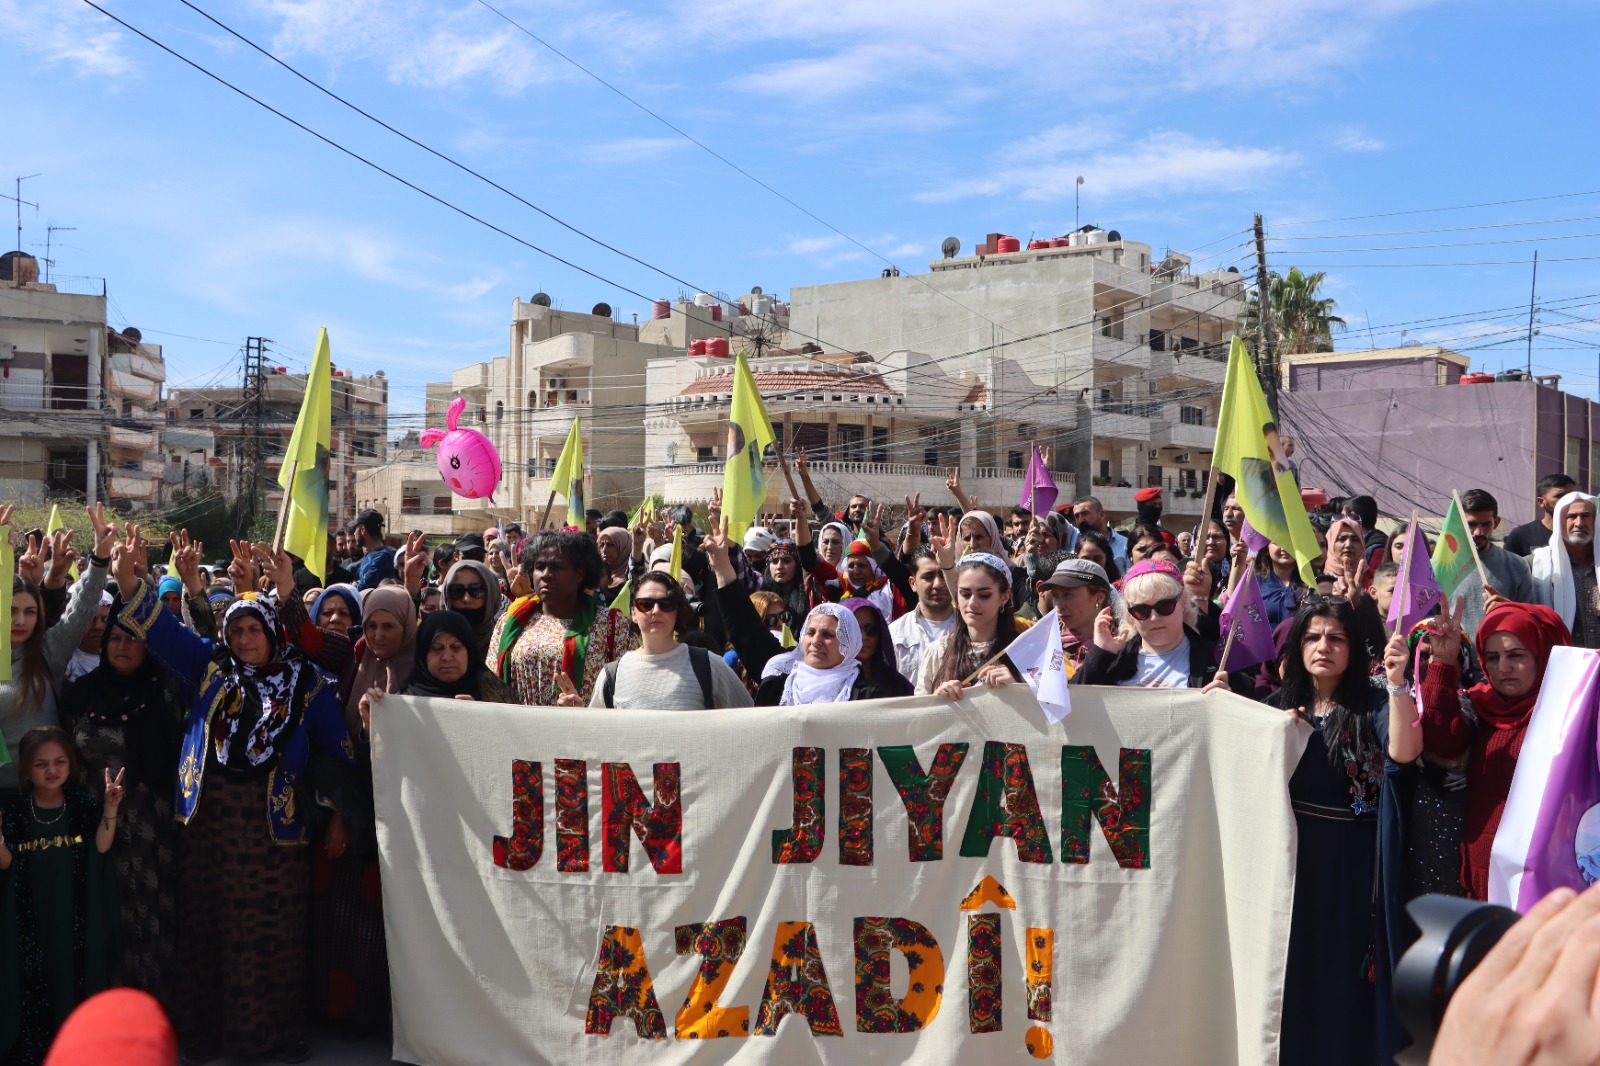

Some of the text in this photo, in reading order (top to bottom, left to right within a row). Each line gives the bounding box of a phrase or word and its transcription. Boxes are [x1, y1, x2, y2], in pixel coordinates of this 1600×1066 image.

[493, 741, 1151, 875] JIN JIYAN
[585, 874, 1055, 1059] AZADÎ!
